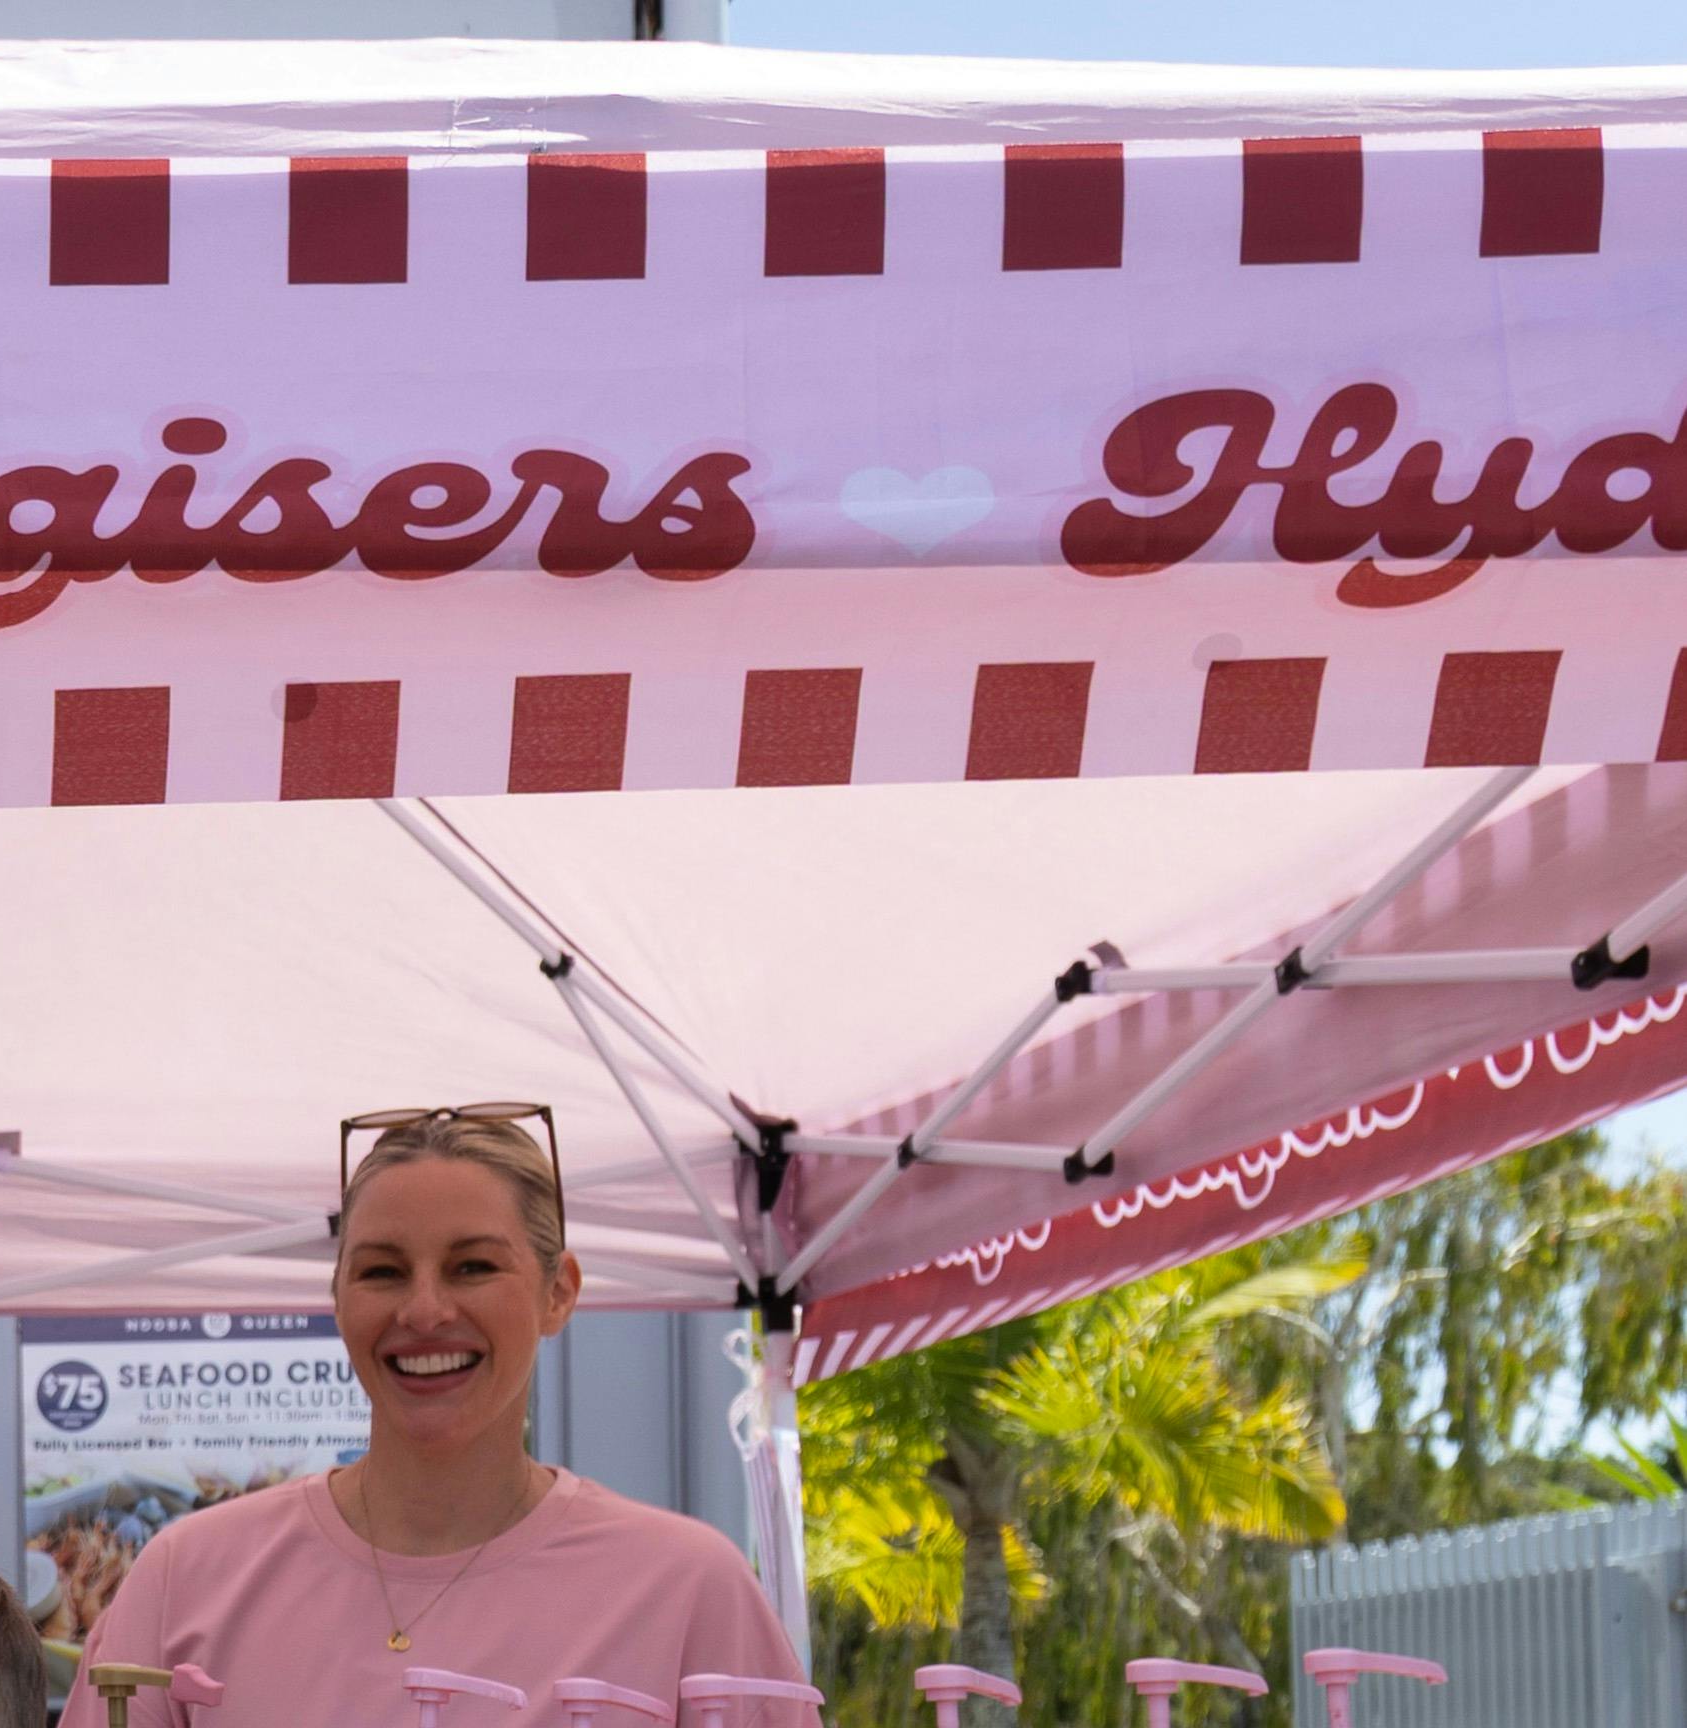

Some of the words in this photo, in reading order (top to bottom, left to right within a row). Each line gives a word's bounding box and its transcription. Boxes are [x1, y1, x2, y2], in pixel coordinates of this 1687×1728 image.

[118, 1362, 272, 1388] SEAFOOD
[145, 1390, 232, 1411] LUNCH
[245, 1388, 372, 1409] INCLUDE
[73, 1437, 143, 1450] Licensed
[194, 1436, 244, 1451] Family
[248, 1435, 310, 1450] Friendly
